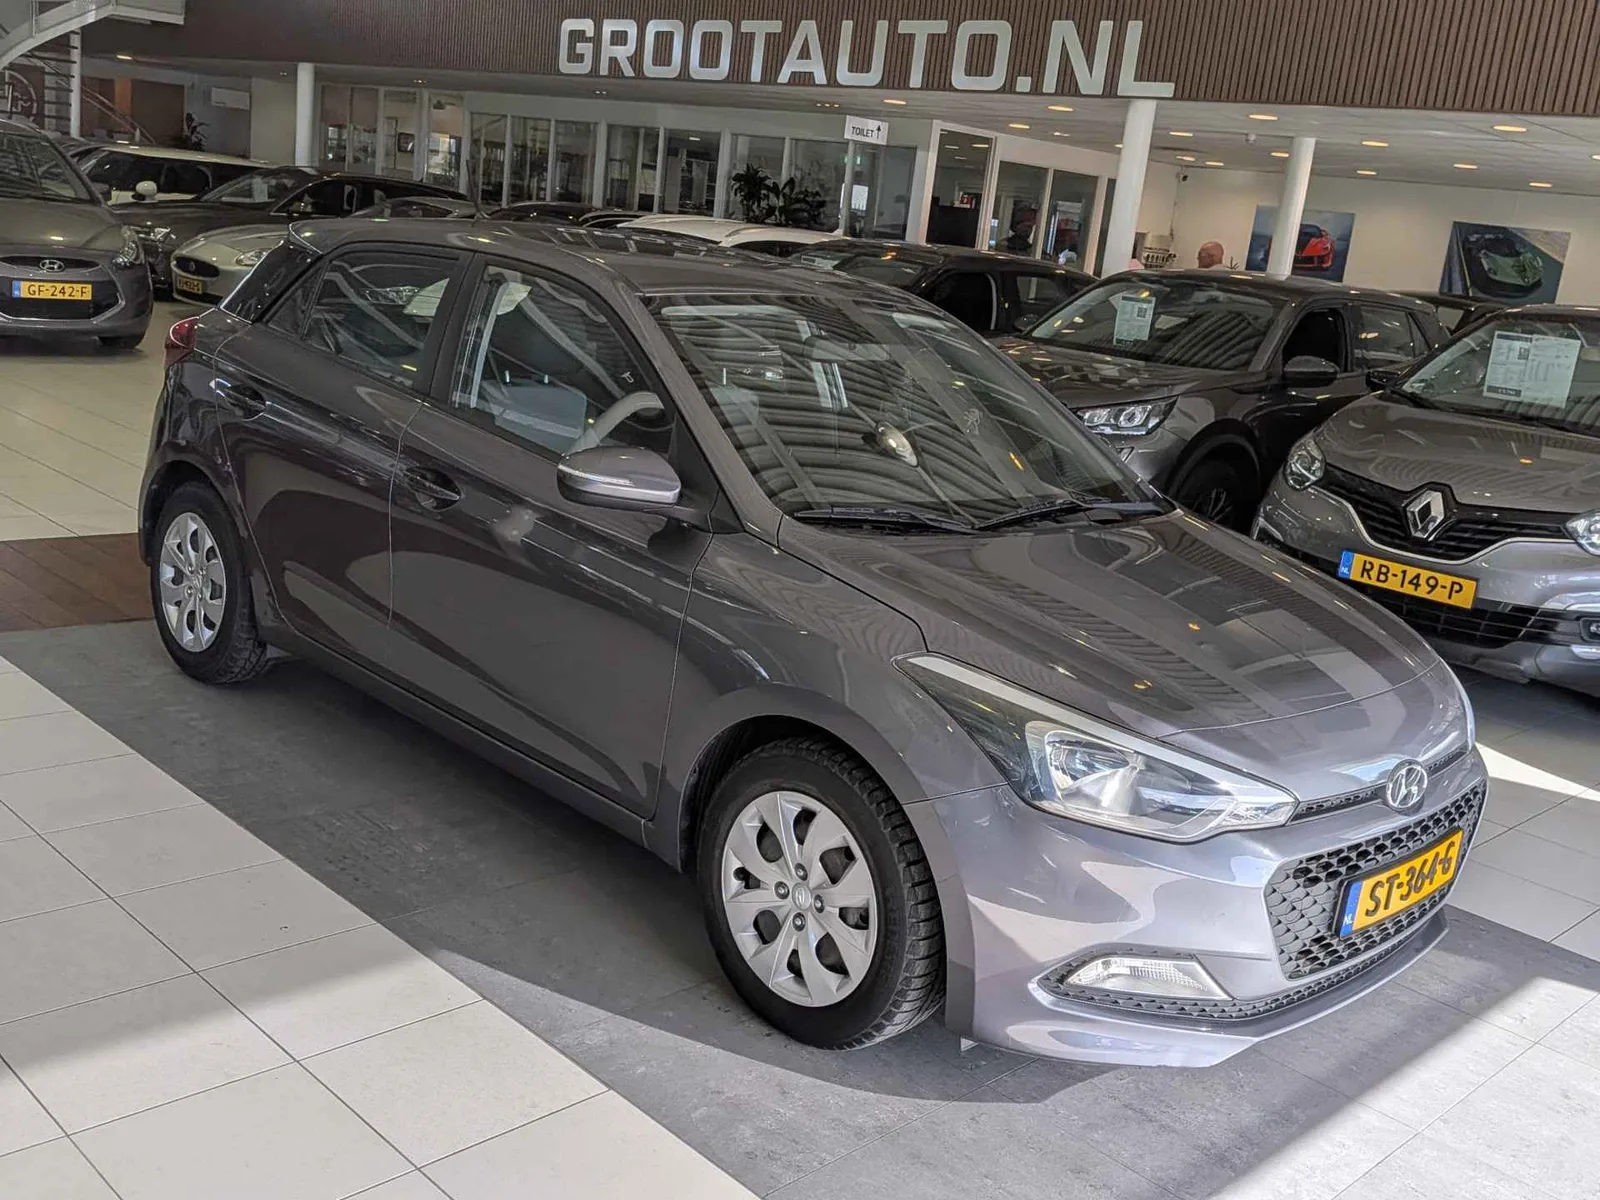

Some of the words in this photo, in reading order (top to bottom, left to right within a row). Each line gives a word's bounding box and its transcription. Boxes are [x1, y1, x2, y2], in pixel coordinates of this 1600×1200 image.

[559, 18, 1175, 97] GROOTAUTO.NL
[851, 126, 874, 138] TOILET
[28, 284, 87, 297] GF-242-F
[1360, 560, 1463, 599] RB-149-P
